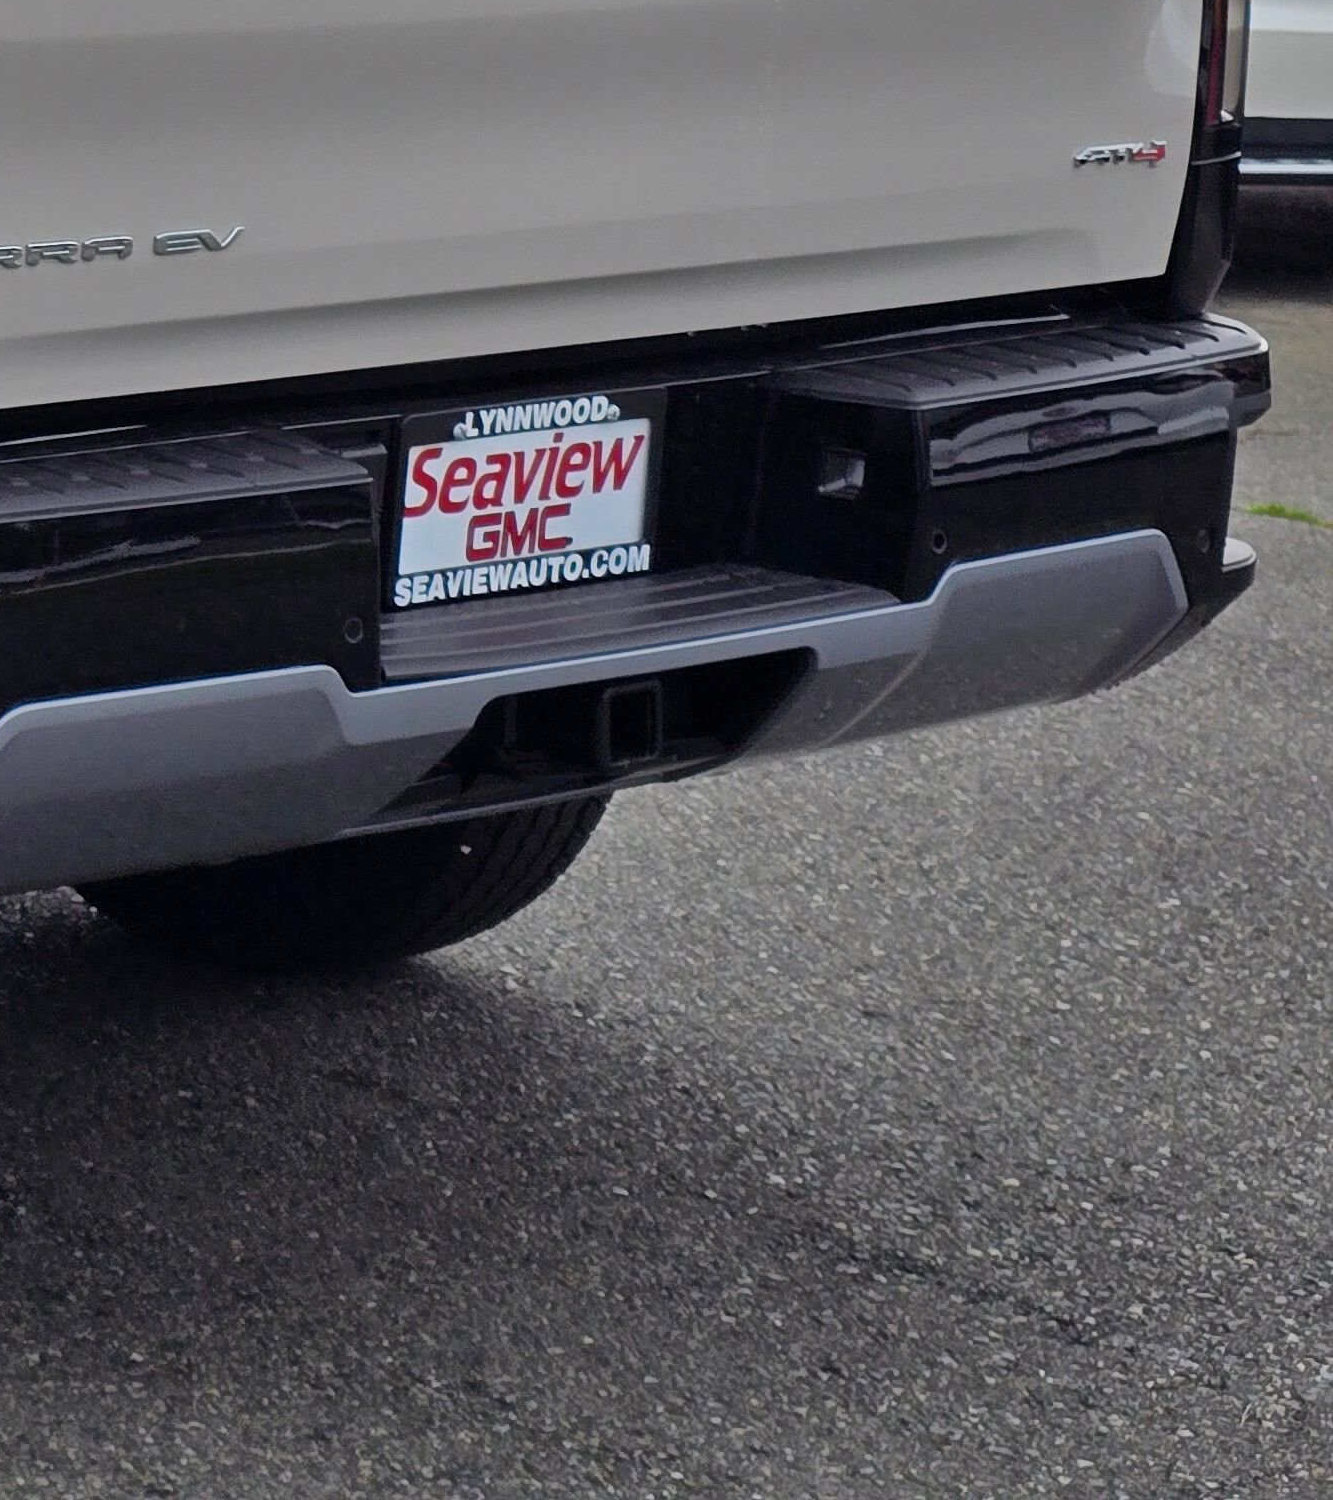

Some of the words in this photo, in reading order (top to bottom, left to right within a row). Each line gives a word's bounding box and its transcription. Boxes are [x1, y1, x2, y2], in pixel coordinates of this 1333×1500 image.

[152, 226, 246, 256] EV
[465, 395, 609, 438] LYNNWOOD
[403, 432, 645, 518] Seaview
[465, 502, 573, 563] GMC
[394, 544, 651, 608] SEAVIEWAUTO.COM
